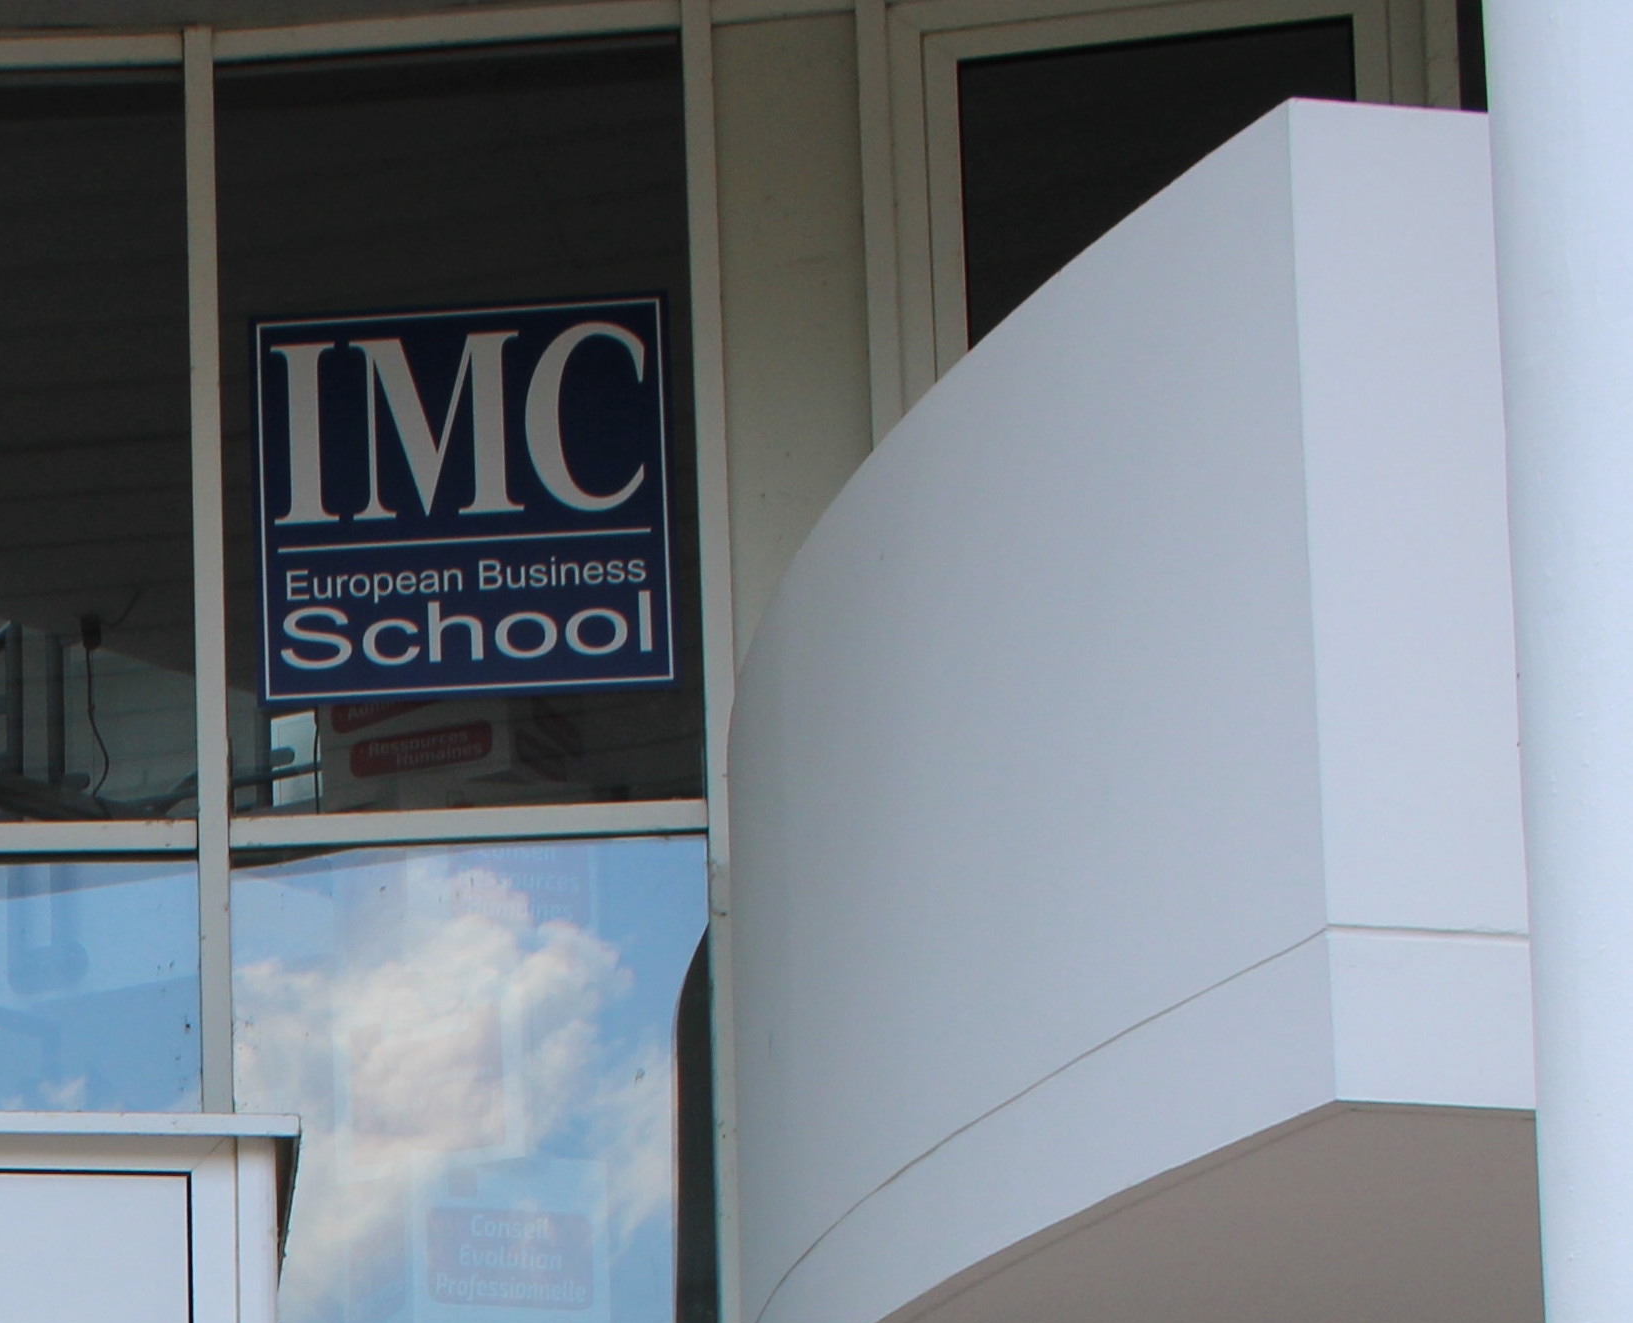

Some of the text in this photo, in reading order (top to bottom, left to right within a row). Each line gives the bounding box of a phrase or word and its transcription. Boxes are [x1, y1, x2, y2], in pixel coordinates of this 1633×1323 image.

[270, 321, 647, 527] IMC
[285, 556, 648, 603] European Business
[280, 590, 654, 670] School
[368, 730, 469, 757] Ressources
[396, 742, 483, 766] Humaines
[470, 1215, 549, 1240] Conseil
[458, 1244, 563, 1271] Evolution
[436, 1272, 587, 1302] Professionnelle
